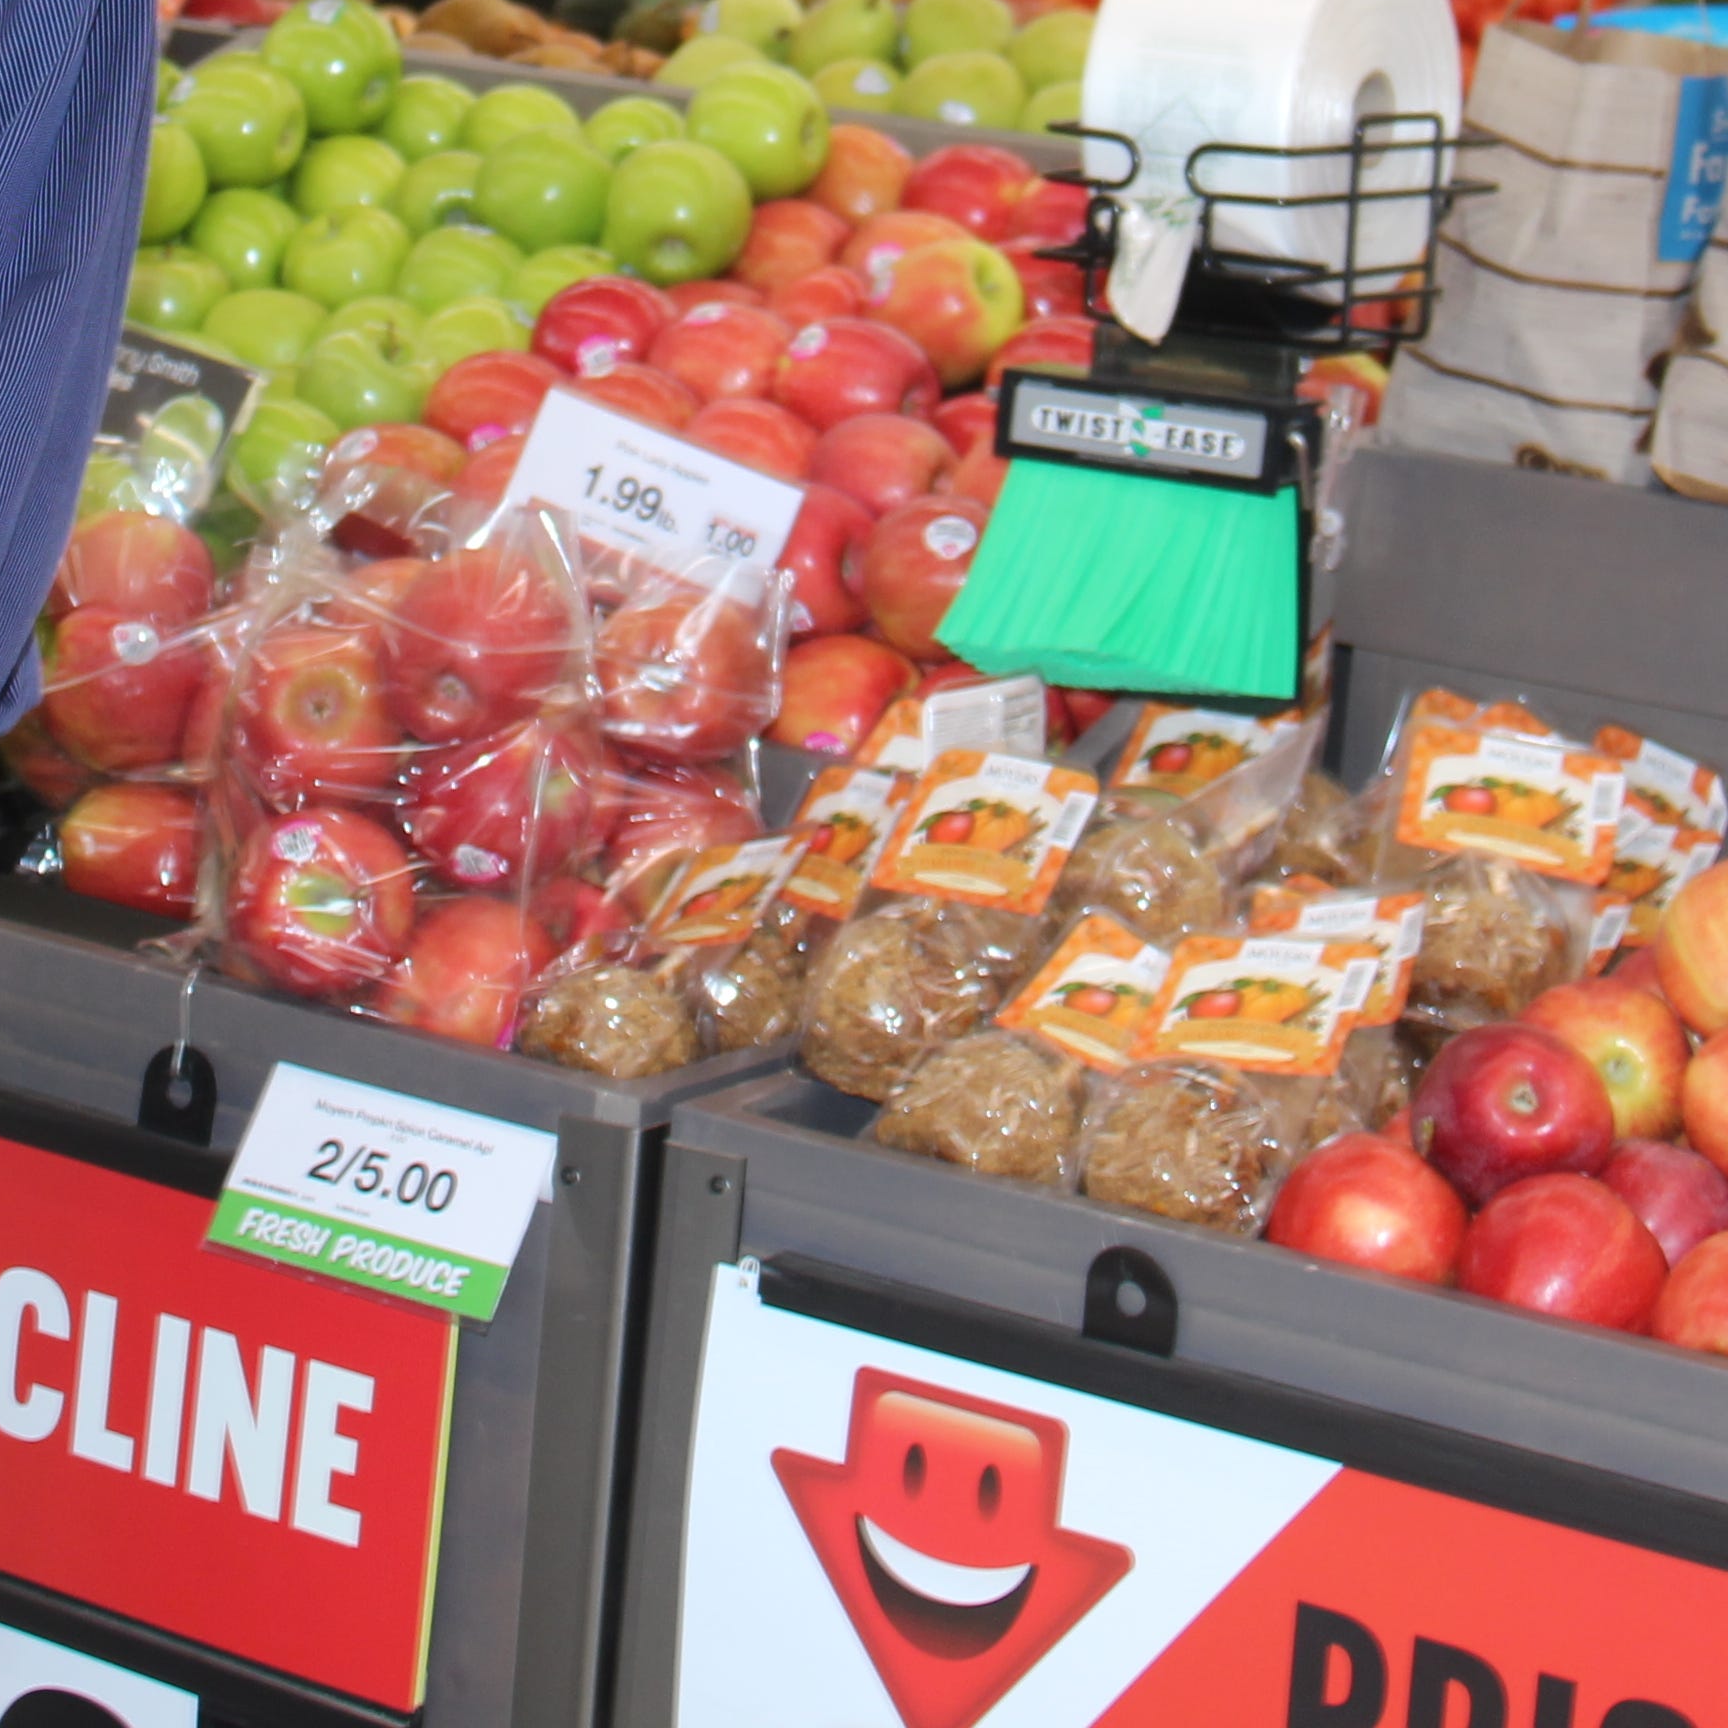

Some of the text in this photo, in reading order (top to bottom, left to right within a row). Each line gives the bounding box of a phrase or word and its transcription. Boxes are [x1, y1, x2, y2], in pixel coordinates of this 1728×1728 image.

[1038, 406, 1126, 440] TWIST
[582, 463, 665, 523] 1.99
[307, 1137, 459, 1214] 2/5.00
[236, 1206, 472, 1300] FRESH PRODUCE
